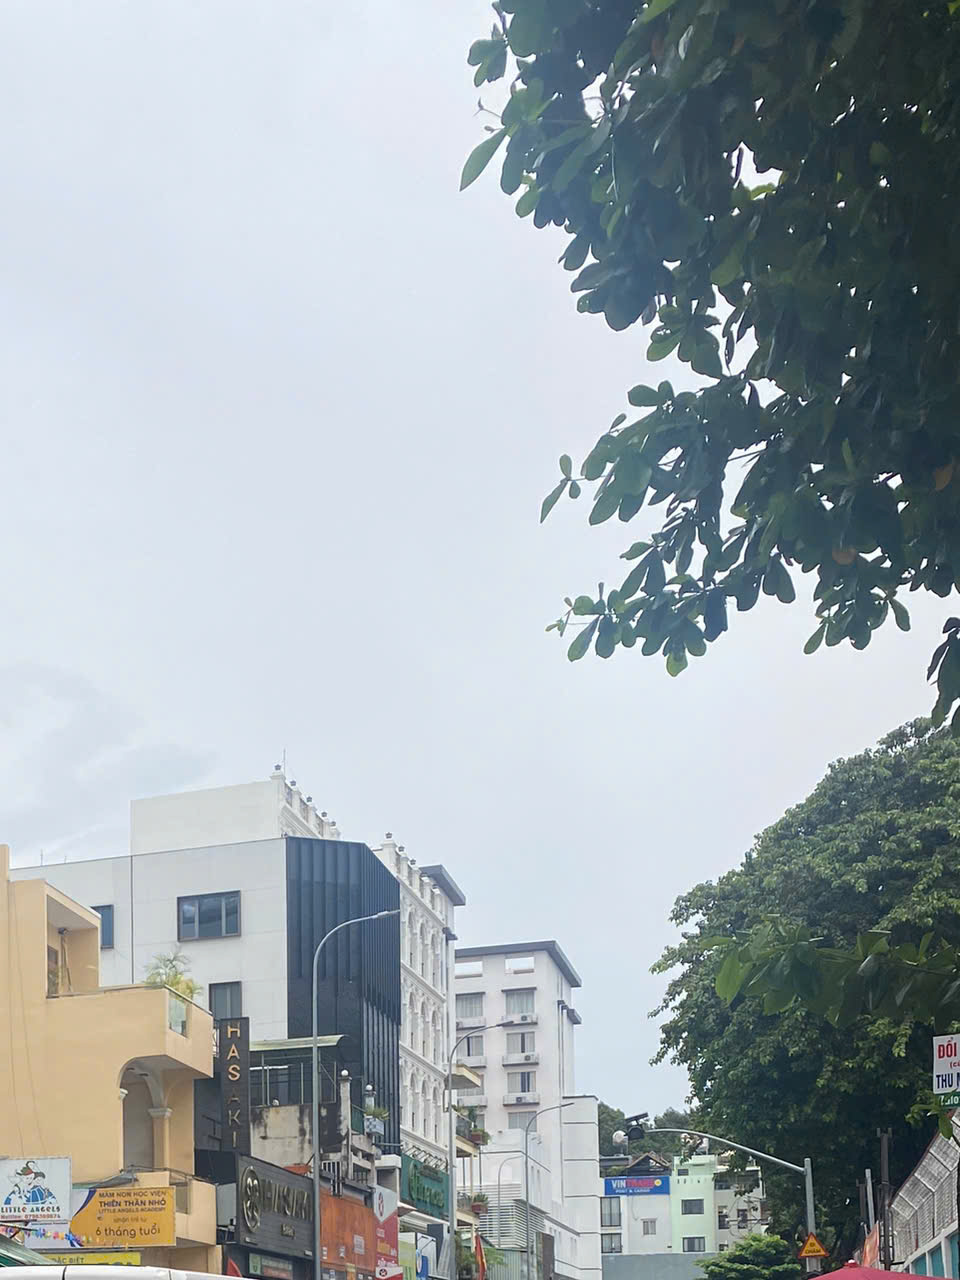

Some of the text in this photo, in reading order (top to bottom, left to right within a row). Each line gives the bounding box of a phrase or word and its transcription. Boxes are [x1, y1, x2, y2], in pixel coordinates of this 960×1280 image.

[936, 1072, 953, 1089] THU
[96, 1222, 160, 1239] 6 tháng tuổi
